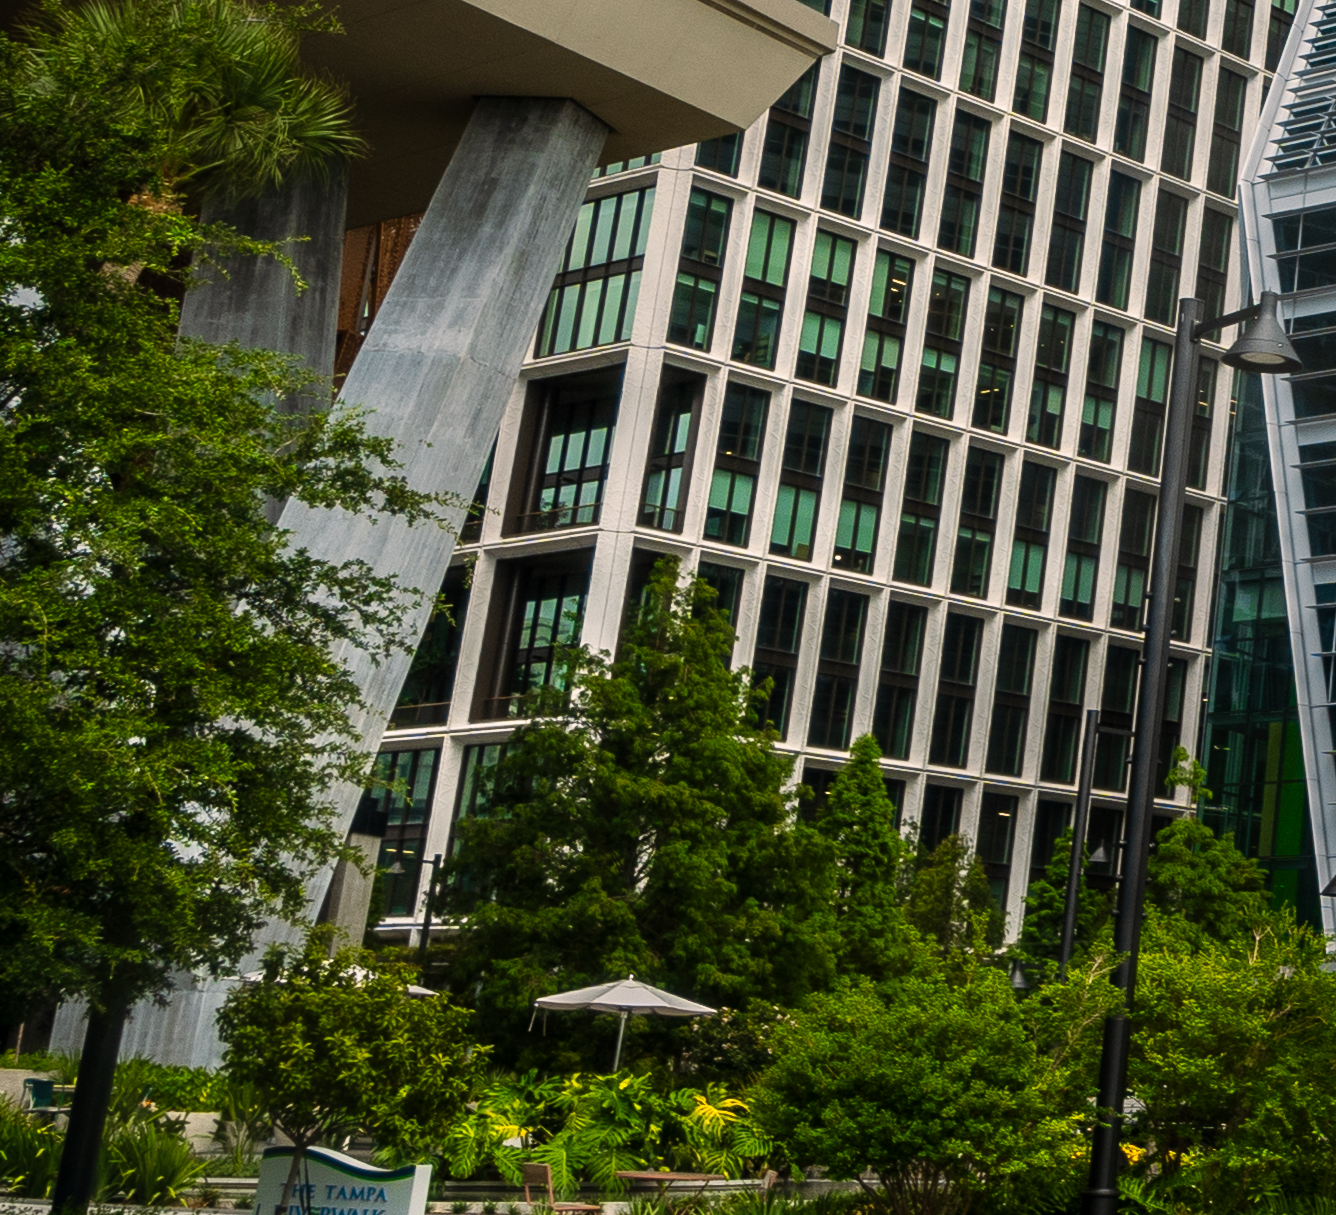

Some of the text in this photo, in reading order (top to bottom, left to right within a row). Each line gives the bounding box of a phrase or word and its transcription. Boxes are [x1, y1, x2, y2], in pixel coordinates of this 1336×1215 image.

[280, 1182, 388, 1202] HE TAMPA
[274, 1204, 387, 1215] IVRWALK
